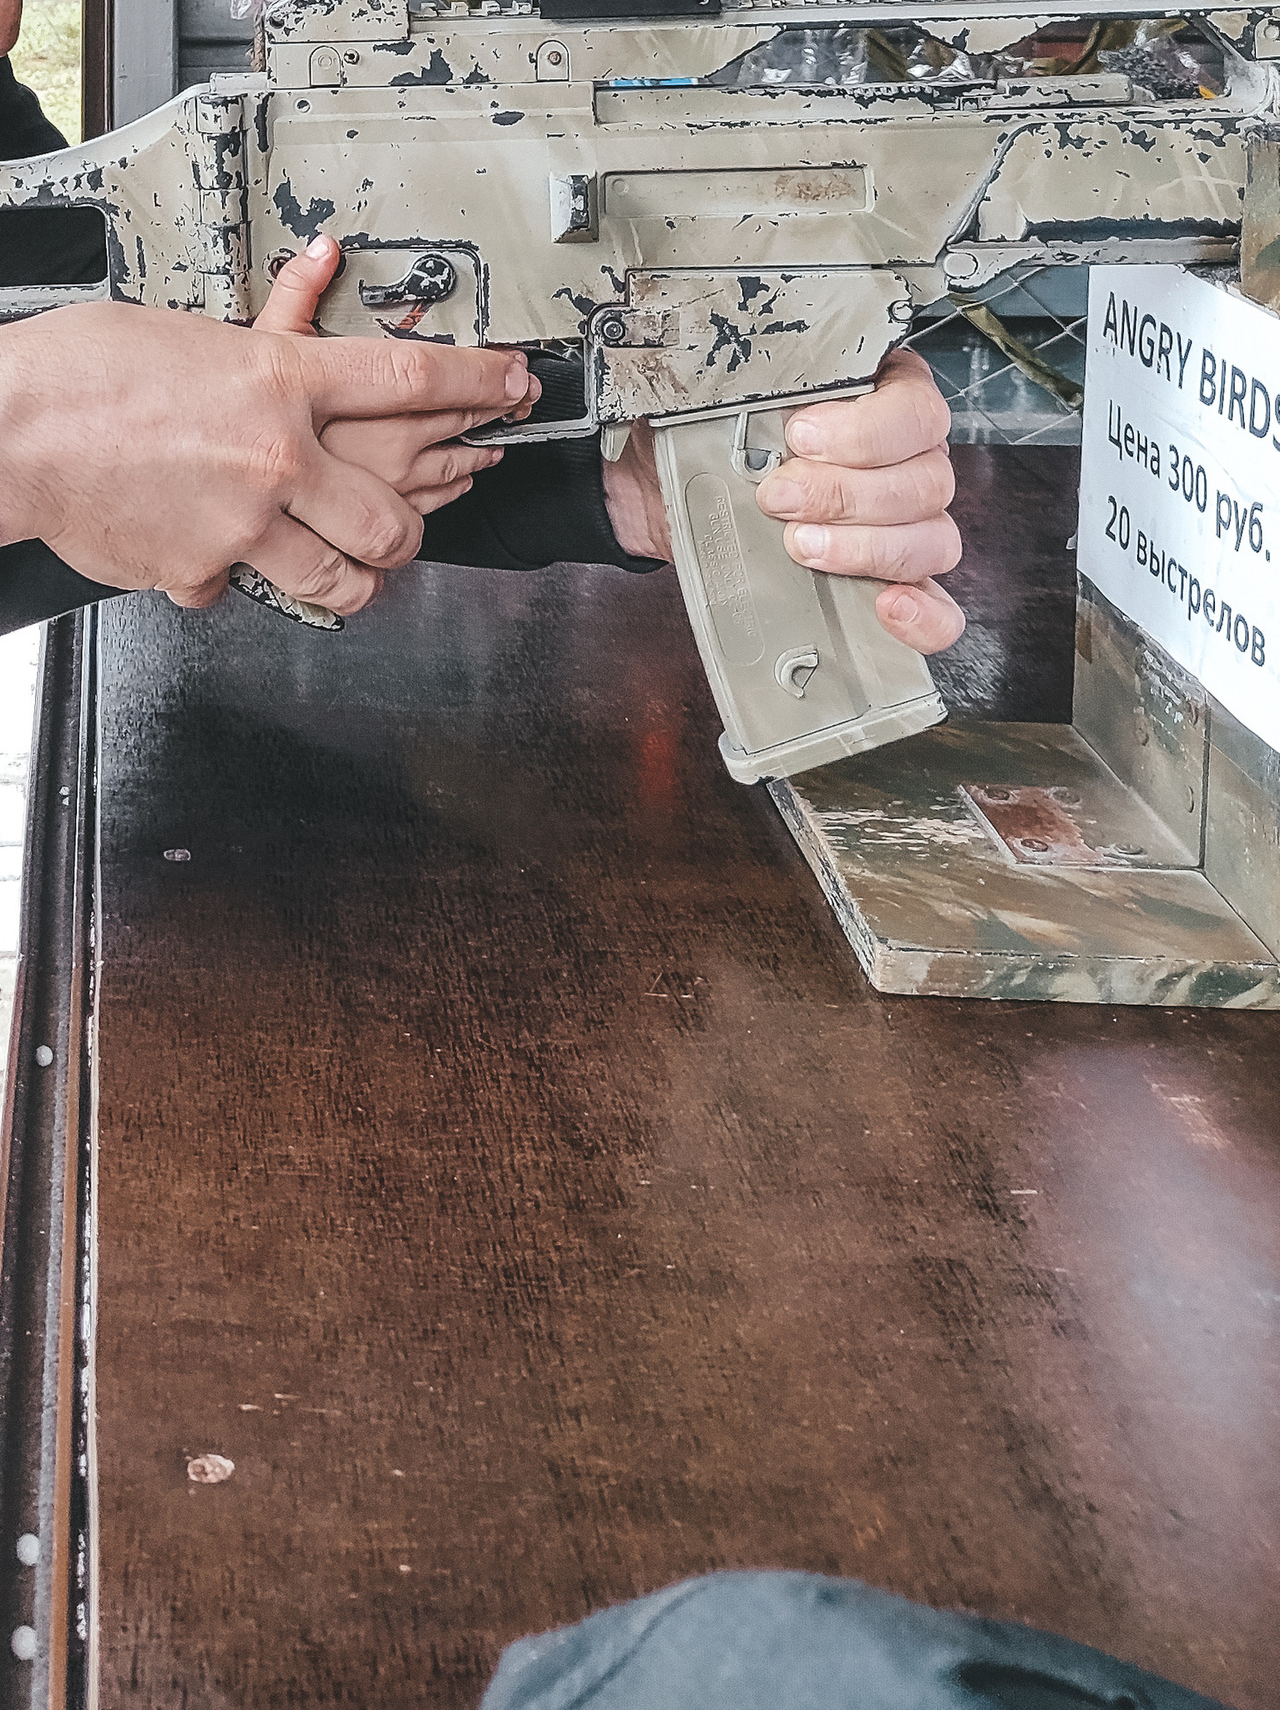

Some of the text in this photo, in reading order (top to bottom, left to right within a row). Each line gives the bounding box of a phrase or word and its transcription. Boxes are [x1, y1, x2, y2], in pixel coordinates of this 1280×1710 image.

[1103, 291, 1192, 389] ANGRY
[1107, 398, 1271, 562] Цена 300 руб.
[1105, 495, 1266, 669] 20 выстрелов
